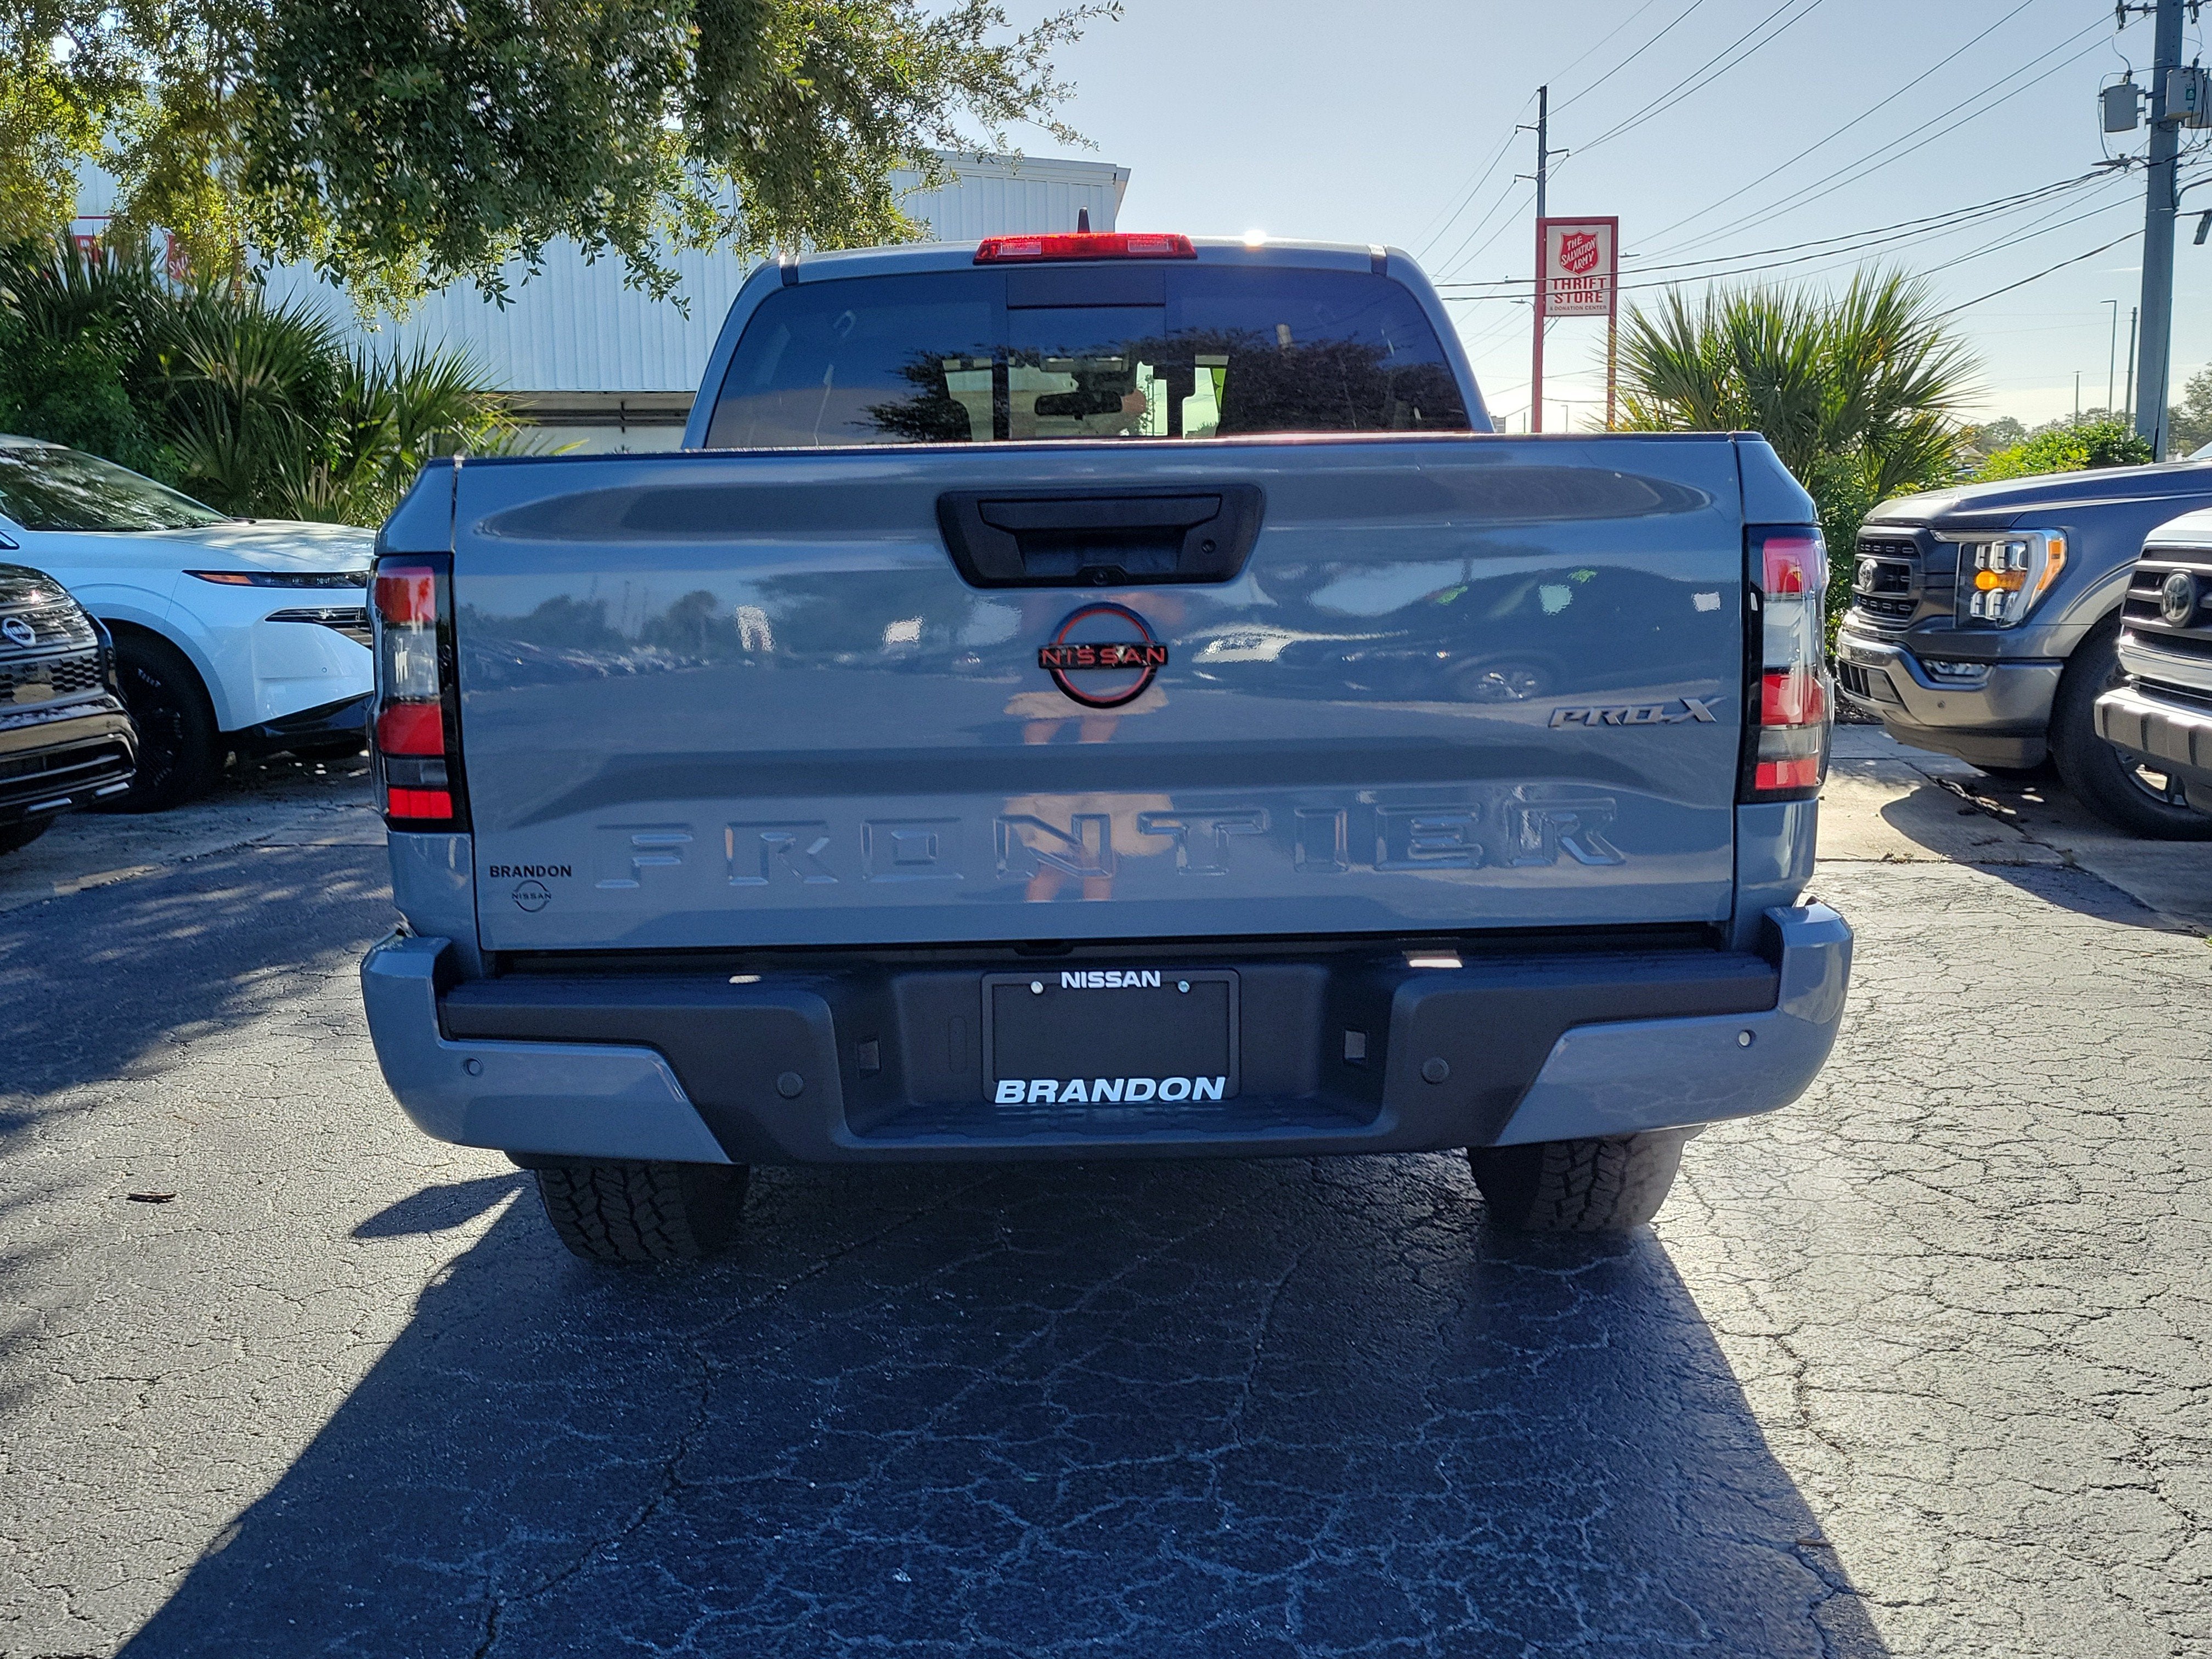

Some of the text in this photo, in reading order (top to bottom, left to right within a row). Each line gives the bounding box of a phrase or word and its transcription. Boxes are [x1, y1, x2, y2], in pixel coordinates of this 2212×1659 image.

[1561, 237, 1595, 266] SALVATION
[1567, 235, 1583, 251] THE
[1572, 250, 1594, 272] ARMY
[1551, 278, 1607, 290] THRIFT
[1554, 291, 1603, 303] STORE
[1042, 647, 1165, 665] NISSAN
[594, 797, 1627, 888] FRONTIER
[489, 865, 572, 877] BRANDON
[1061, 970, 1161, 989] NISSAN
[995, 1076, 1226, 1103] BRANDON
